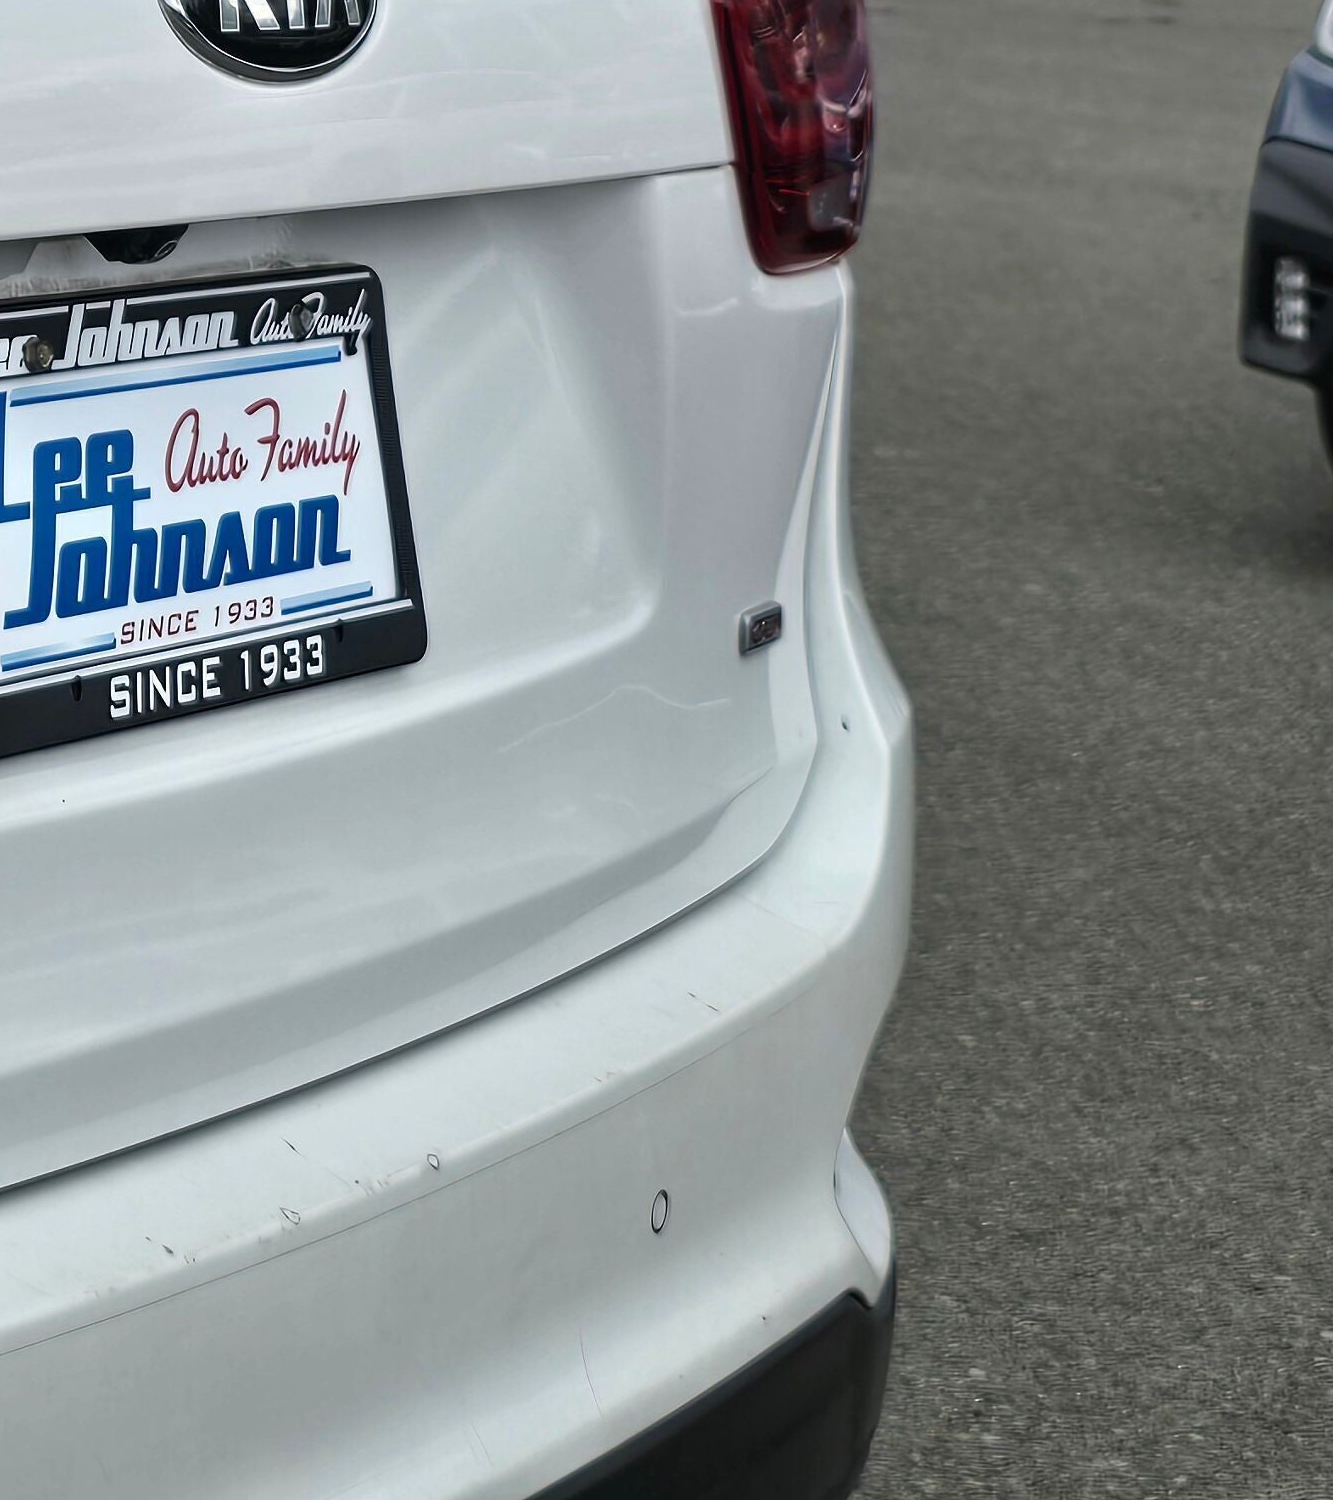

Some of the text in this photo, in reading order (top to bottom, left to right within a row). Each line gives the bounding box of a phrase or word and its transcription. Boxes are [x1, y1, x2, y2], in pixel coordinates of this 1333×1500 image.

[51, 298, 239, 371] Johnson
[250, 297, 303, 345] Aut
[164, 389, 361, 496] Auto Family
[3, 476, 351, 630] Johnson
[119, 595, 276, 645] SINCE 1933
[108, 633, 325, 721] SINCE 1933
